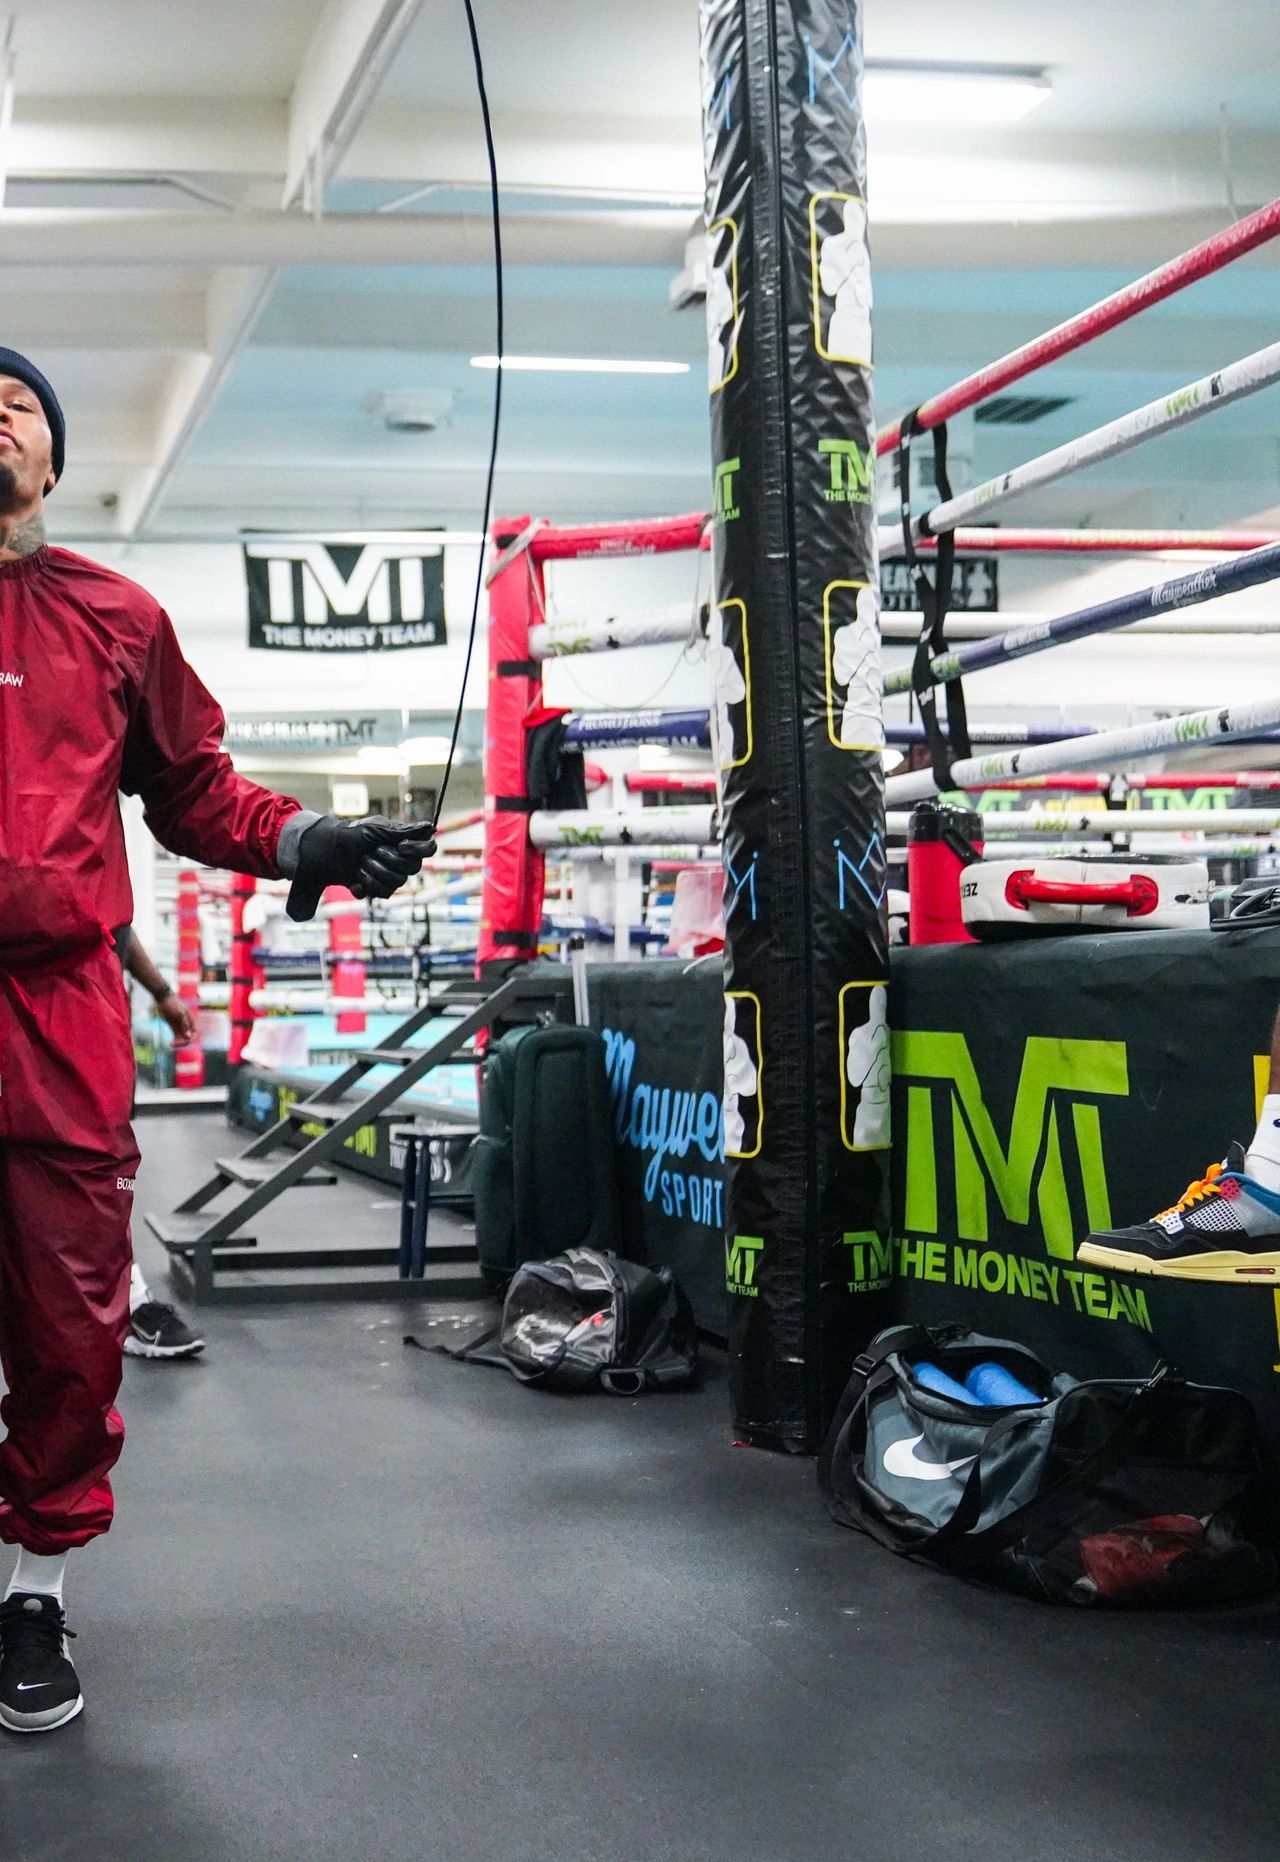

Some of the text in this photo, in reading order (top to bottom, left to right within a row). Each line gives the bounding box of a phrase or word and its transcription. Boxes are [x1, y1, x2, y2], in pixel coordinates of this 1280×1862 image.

[824, 489, 845, 501] THE
[246, 543, 442, 625] TMT
[262, 622, 436, 648] THE MONEY TEAM
[602, 1028, 725, 1201] Maywe
[889, 1030, 1129, 1261] TMT
[738, 1284, 758, 1297] TEAM
[848, 1281, 867, 1293] THE
[954, 1246, 1059, 1305] MONEY
[1062, 1269, 1153, 1333] TEAM
